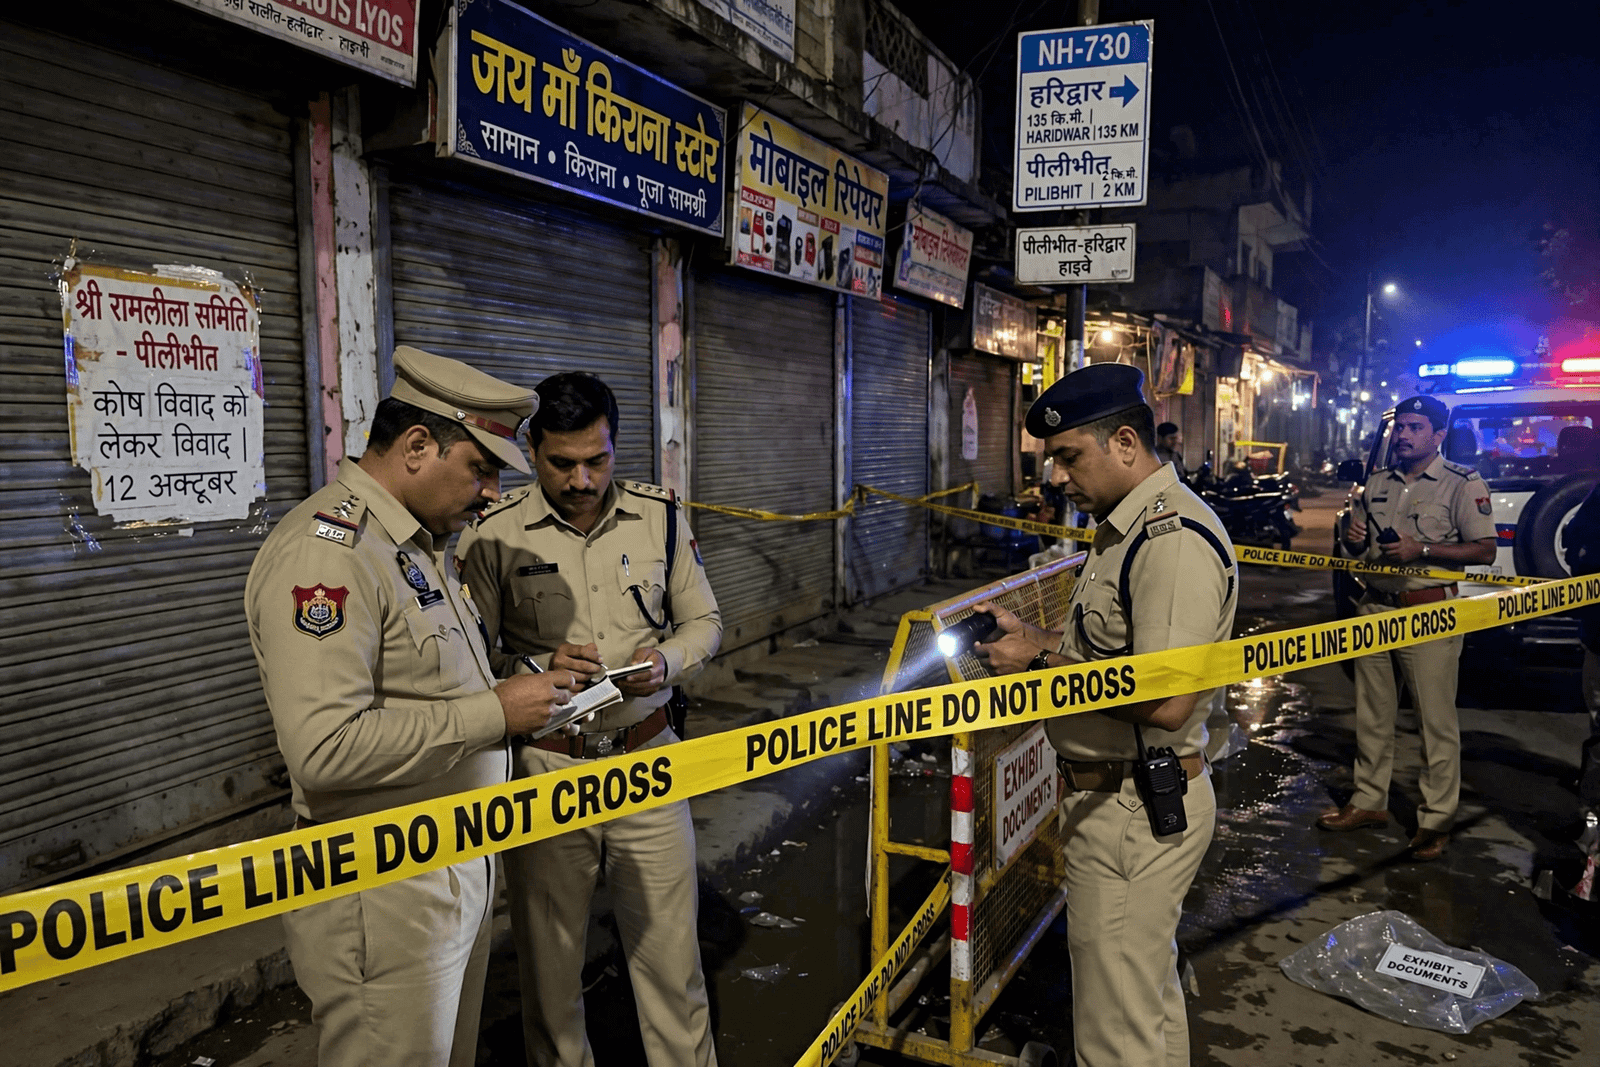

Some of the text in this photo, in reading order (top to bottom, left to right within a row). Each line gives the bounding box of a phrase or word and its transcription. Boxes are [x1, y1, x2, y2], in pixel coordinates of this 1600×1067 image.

[1038, 32, 1130, 66] NH-730
[471, 29, 720, 184] जय माँ किराना स्टोर
[1029, 77, 1106, 108] हरिद्वार
[1026, 122, 1138, 144] HARIDWAR 135 KM
[1027, 108, 1084, 127] 135 कि.मी.
[480, 120, 540, 164] सामान
[564, 140, 617, 189] किराना
[637, 174, 664, 209] पूजा
[668, 188, 706, 218] सामग्री
[749, 121, 884, 229] मोबाइल रिपेयर
[1026, 150, 1112, 178] पीलीभीत
[1102, 170, 1109, 181] 2
[1025, 182, 1135, 201] PILIBHIT 2 KM
[1023, 233, 1127, 254] पीलीभीत-हरिद्वार
[1058, 255, 1093, 277] हाइवे
[75, 279, 248, 332] श्री रामलीला समिति
[134, 330, 218, 371] पीलीभीत
[93, 380, 248, 421] कोष विवाद को
[98, 423, 162, 459] लेकर
[172, 423, 231, 459] विवाद
[105, 471, 237, 503] 12 अक्टूबर
[1243, 549, 1280, 563] POLICE
[1283, 553, 1306, 565] LINE
[1309, 556, 1325, 567] DO
[1327, 558, 1351, 569] NOT
[1390, 565, 1431, 576] CROSS
[1498, 591, 1538, 620] POLICE
[1542, 585, 1565, 611] LINE
[1568, 582, 1582, 604] DO
[1243, 606, 1456, 674] POLICE LINE DO NOT CROSS
[746, 664, 1136, 773] POLICE LINE DO NOT CROSS
[1003, 736, 1045, 801] EXHIBIT
[1002, 773, 1051, 846] DOCUMENTS
[0, 756, 672, 975] POLICE LINE DO NOT CROSS
[1387, 961, 1468, 989] DOCUMENTS
[1403, 954, 1455, 975] EXHIBIT
[821, 1003, 857, 1067] POLICE
[859, 975, 879, 1019] LINE
[881, 959, 893, 991] DO
[894, 934, 911, 974] NOT
